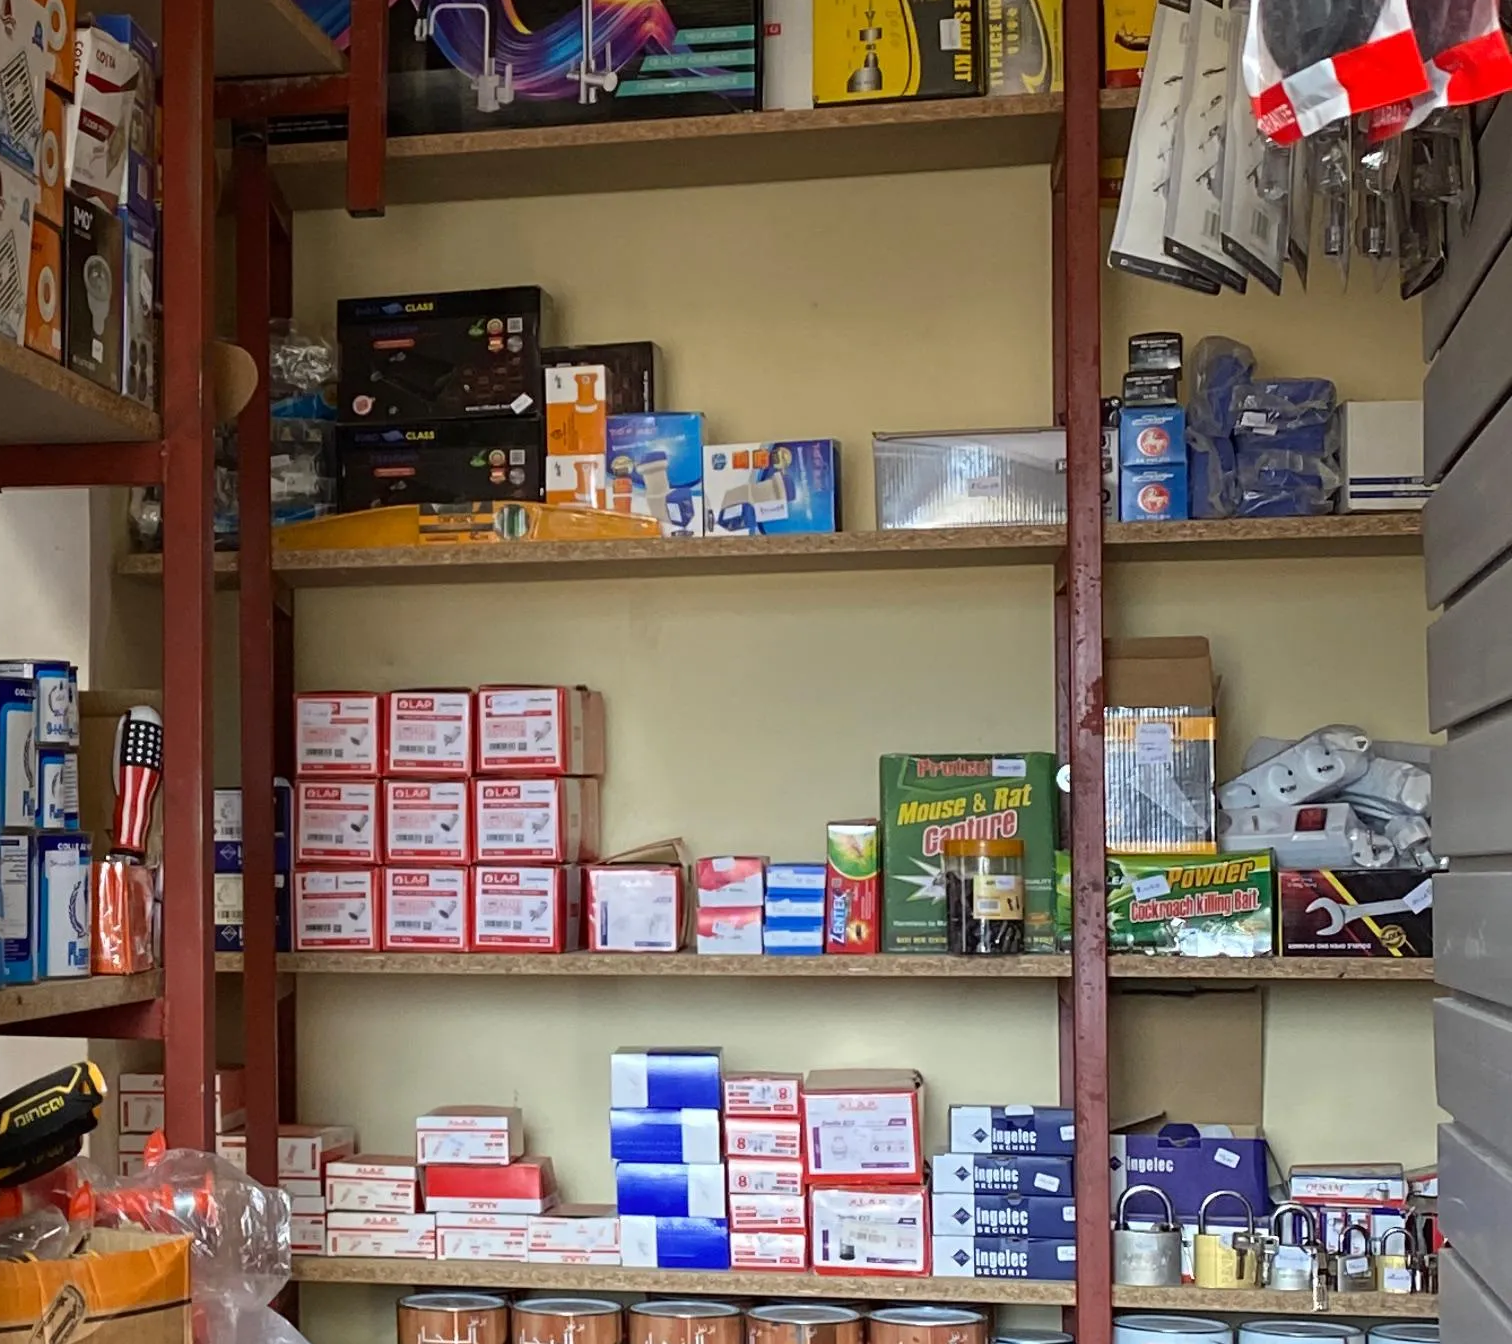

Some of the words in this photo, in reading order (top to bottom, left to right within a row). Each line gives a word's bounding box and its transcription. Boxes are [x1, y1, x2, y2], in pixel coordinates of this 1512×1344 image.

[989, 24, 1003, 68] PIECE
[95, 48, 117, 69] COSTA
[954, 54, 972, 82] KIT
[405, 302, 434, 313] CLASS
[405, 431, 435, 440] CLASS
[897, 796, 968, 825] Mouse
[973, 793, 986, 812] &
[994, 783, 1033, 809] Rat
[1167, 859, 1256, 889] Powder
[1129, 899, 1193, 923] Cockroach
[1234, 889, 1260, 911] Bait
[777, 1087, 788, 1100] 8
[736, 1136, 746, 1149] 8
[738, 1174, 748, 1188] 8
